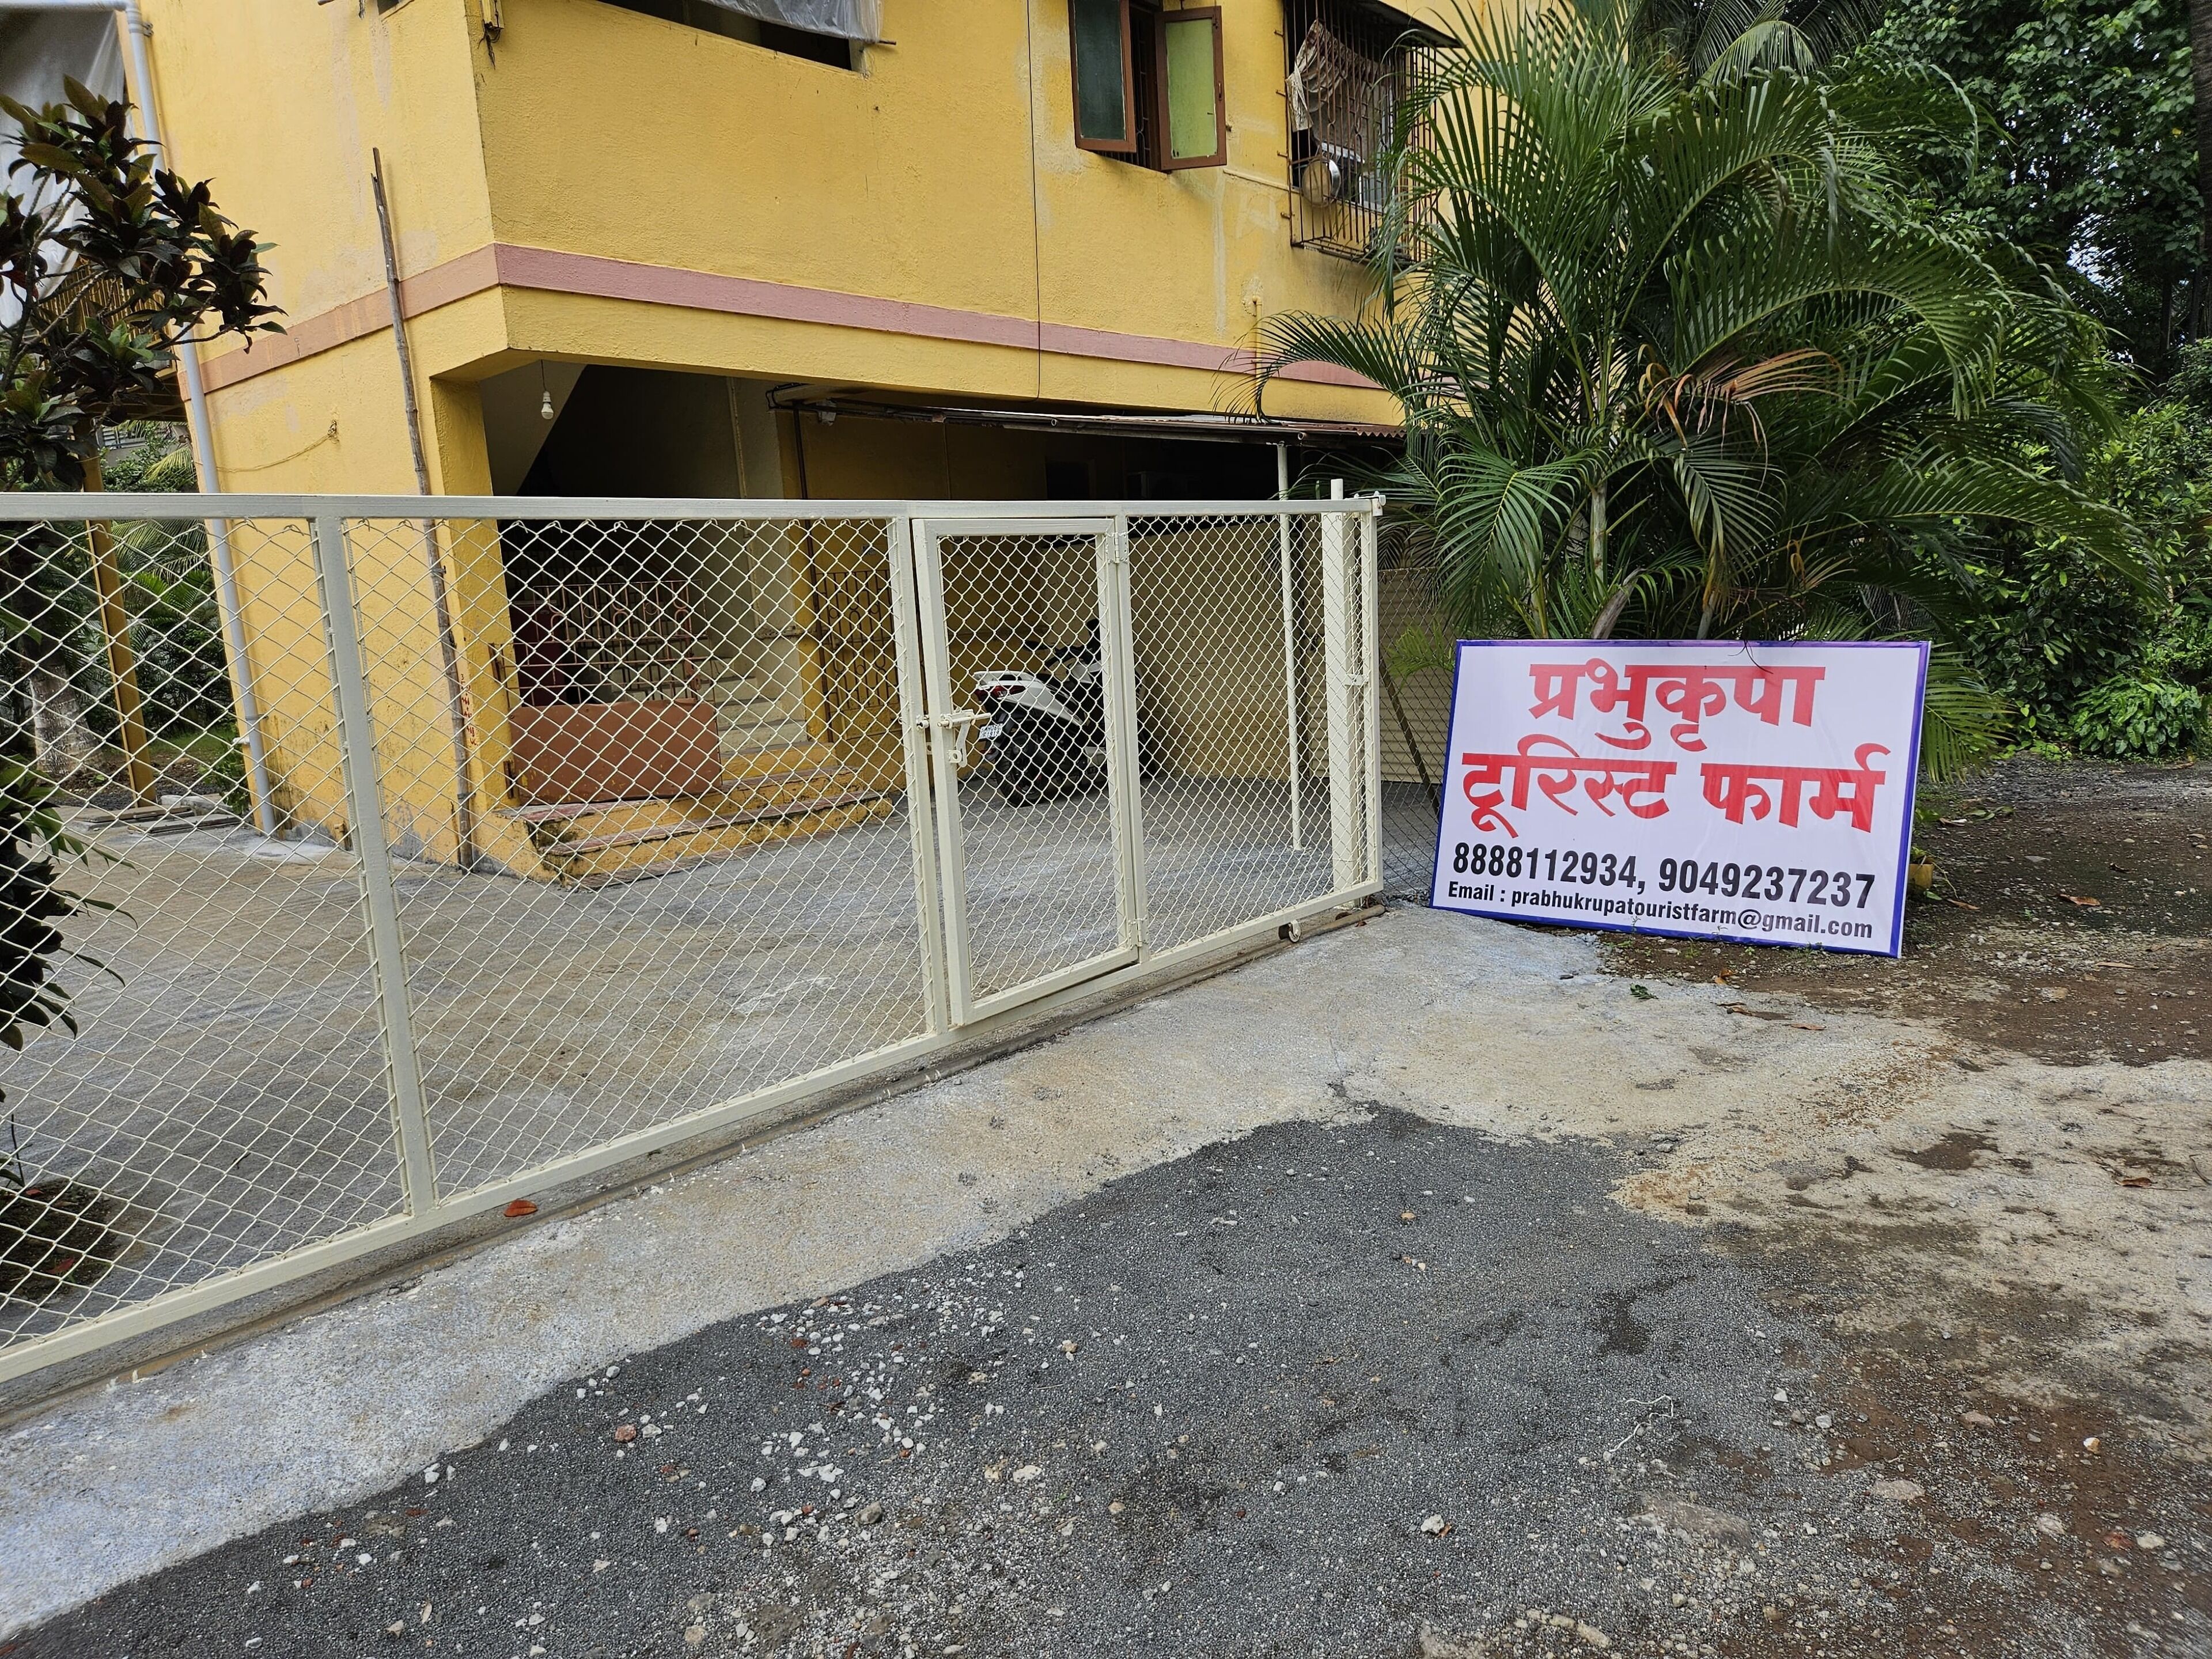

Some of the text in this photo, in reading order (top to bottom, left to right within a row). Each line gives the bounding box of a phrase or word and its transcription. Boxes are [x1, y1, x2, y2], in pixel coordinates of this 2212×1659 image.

[1530, 658, 1825, 752] प्रभुकृपा
[1461, 734, 1891, 838] टूरिस्ट फार्म
[1448, 881, 1873, 939] Email : prabhukrupatouristfarm@gmail.com
[1453, 842, 1876, 909] 8888112934, 9049237237
